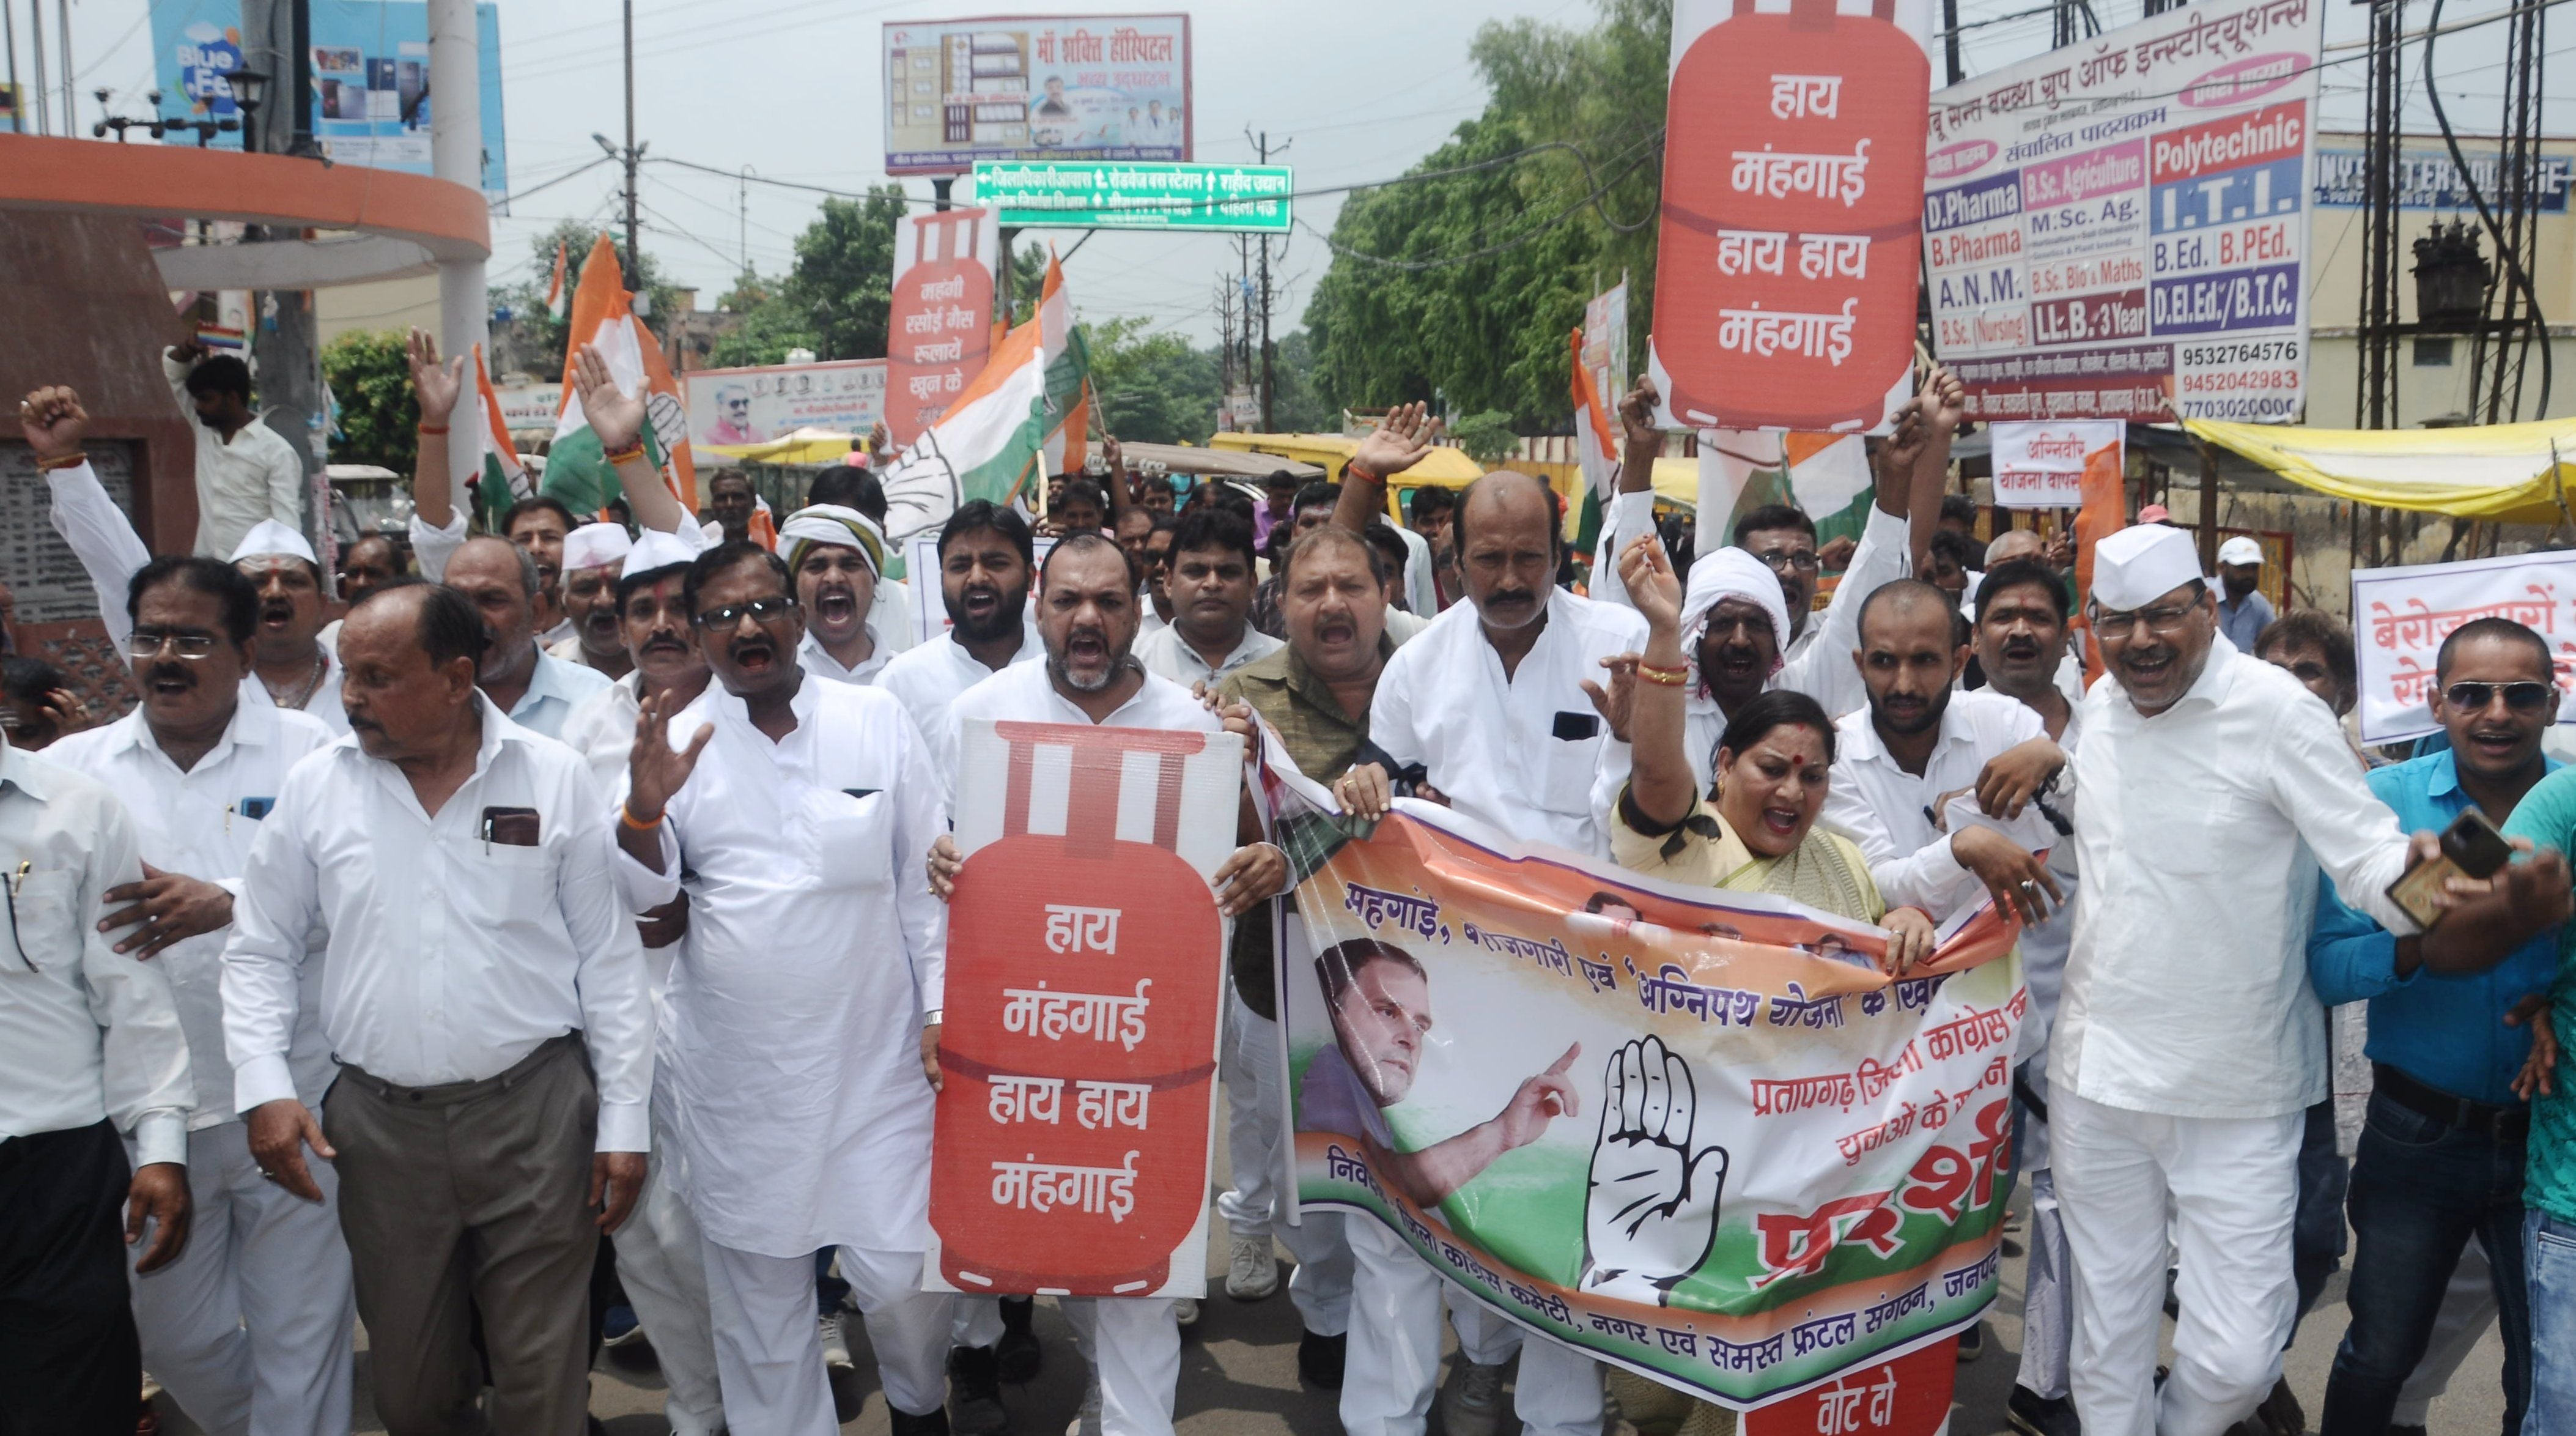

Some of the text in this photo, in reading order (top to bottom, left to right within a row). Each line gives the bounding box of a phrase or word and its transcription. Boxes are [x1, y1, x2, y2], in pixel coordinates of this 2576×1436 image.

[177, 45, 234, 69] Blue
[2078, 43, 2128, 89] ऑफ
[1771, 73, 1842, 120] हाय
[2005, 131, 2073, 163] संचालित
[2155, 113, 2300, 176] Polytechnic
[1731, 138, 1872, 209] मंहगाई
[2026, 152, 2140, 203] B.Sc. Agriculture
[1926, 183, 2018, 231] D.Pharma
[2031, 198, 2140, 234] M.Sc. Ag.
[2163, 169, 2293, 231] I.T.I.
[1716, 228, 1872, 280] हाय हाय
[1931, 228, 2021, 267] B.Pharma
[2155, 223, 2291, 273] B.Ed. B.PEd.
[1939, 268, 2024, 309] A.N.M.
[2031, 270, 2064, 294] B.Sc.
[2065, 264, 2087, 290] Bio
[2100, 257, 2142, 284] Maths
[906, 306, 944, 335] रसोई
[1718, 297, 1858, 367] मंहगाई
[1941, 319, 1971, 347] B.Sc.
[2100, 302, 2110, 337] 3
[2111, 302, 2146, 335] Year
[2183, 341, 2298, 366] 9532764576
[909, 367, 963, 401] खून के
[2183, 369, 2298, 392] 9452042983
[1999, 463, 2043, 490] योजना
[2371, 583, 2558, 650] बेरोजरों
[1044, 903, 1122, 955] हाय
[1577, 952, 1617, 994] एवं
[1003, 978, 1153, 1053] मंहगाई
[1751, 1073, 1856, 1117] प्रतापगढ़
[1923, 1004, 2010, 1061] कांग्रेस
[987, 1074, 1153, 1131] हाय हाय
[1921, 1089, 1949, 1131] के
[991, 1150, 1140, 1224] मंहगाई
[1587, 1311, 1650, 1345] नगर
[1655, 1323, 1697, 1357] एवं
[1706, 1332, 1785, 1374] समस्त
[1791, 1310, 1856, 1358] फ्रंटल
[1943, 1245, 1999, 1299] जनपद
[1817, 1365, 1897, 1436] वोट दो
